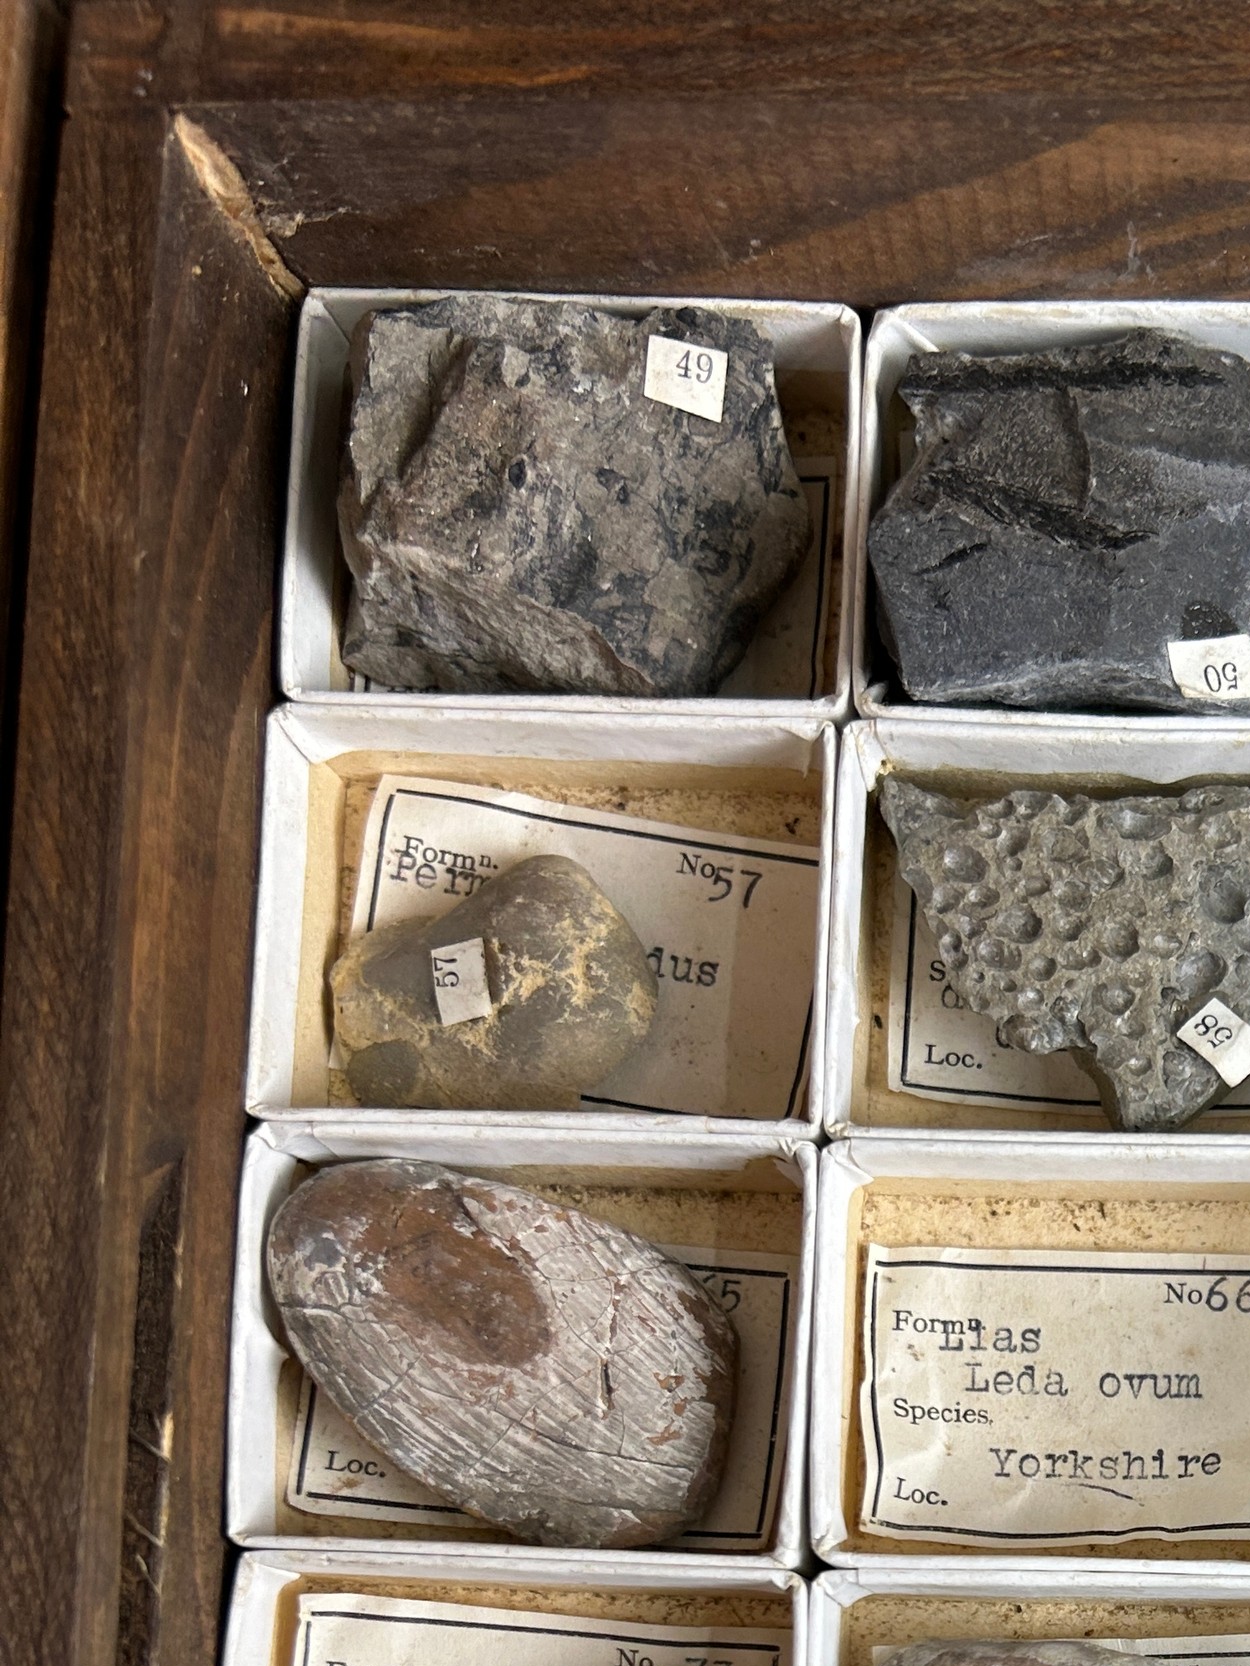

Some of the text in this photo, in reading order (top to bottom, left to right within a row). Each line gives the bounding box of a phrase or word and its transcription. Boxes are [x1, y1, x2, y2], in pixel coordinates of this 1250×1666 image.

[676, 350, 714, 385] 49
[1204, 662, 1238, 693] 50
[434, 956, 459, 988] 57
[1193, 1013, 1233, 1050] 58
[925, 1044, 983, 1070] Loc.
[940, 1324, 1042, 1354] Lias
[964, 1362, 1203, 1400] Leda ovum
[325, 1449, 386, 1479] Loc.
[989, 1447, 1222, 1481] Yorkshire
[893, 1477, 948, 1506] Loc.
